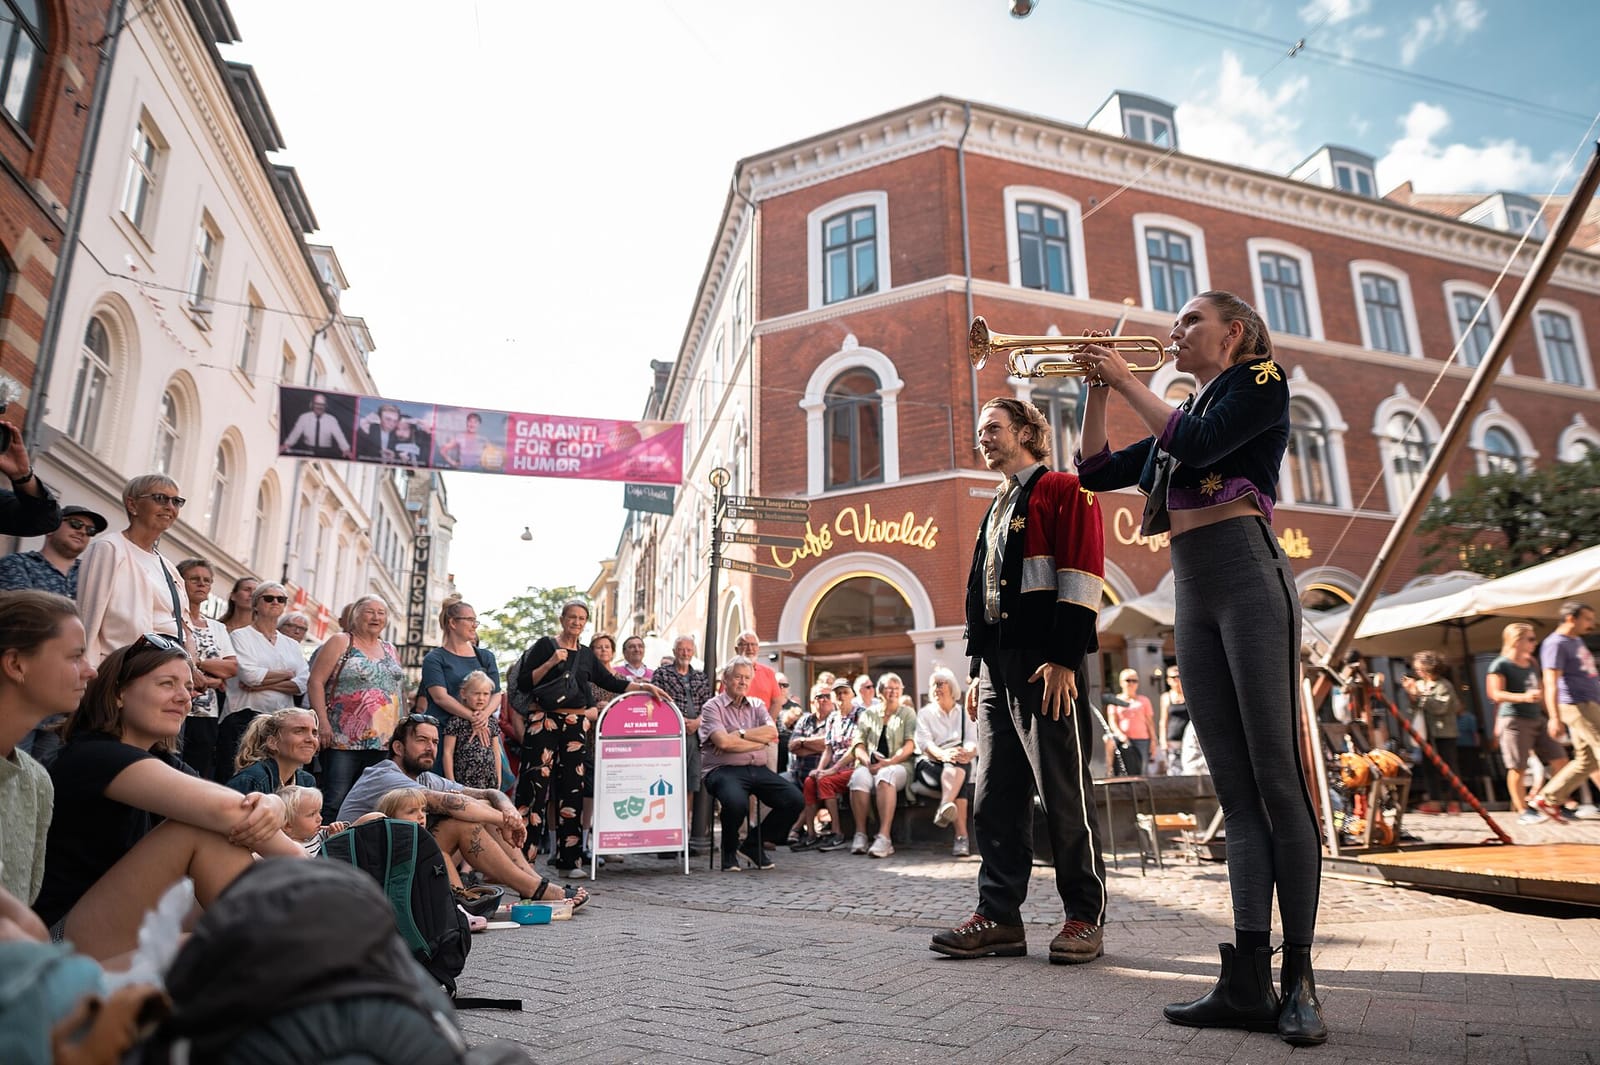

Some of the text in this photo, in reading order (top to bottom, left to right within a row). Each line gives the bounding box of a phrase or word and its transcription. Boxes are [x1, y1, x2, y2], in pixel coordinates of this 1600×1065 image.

[515, 420, 597, 442] GARANTI
[514, 439, 605, 459] FOR GODT
[513, 456, 581, 473] HUMØR
[834, 503, 939, 550] Vivaldi
[407, 537, 429, 643] GULDSMED
